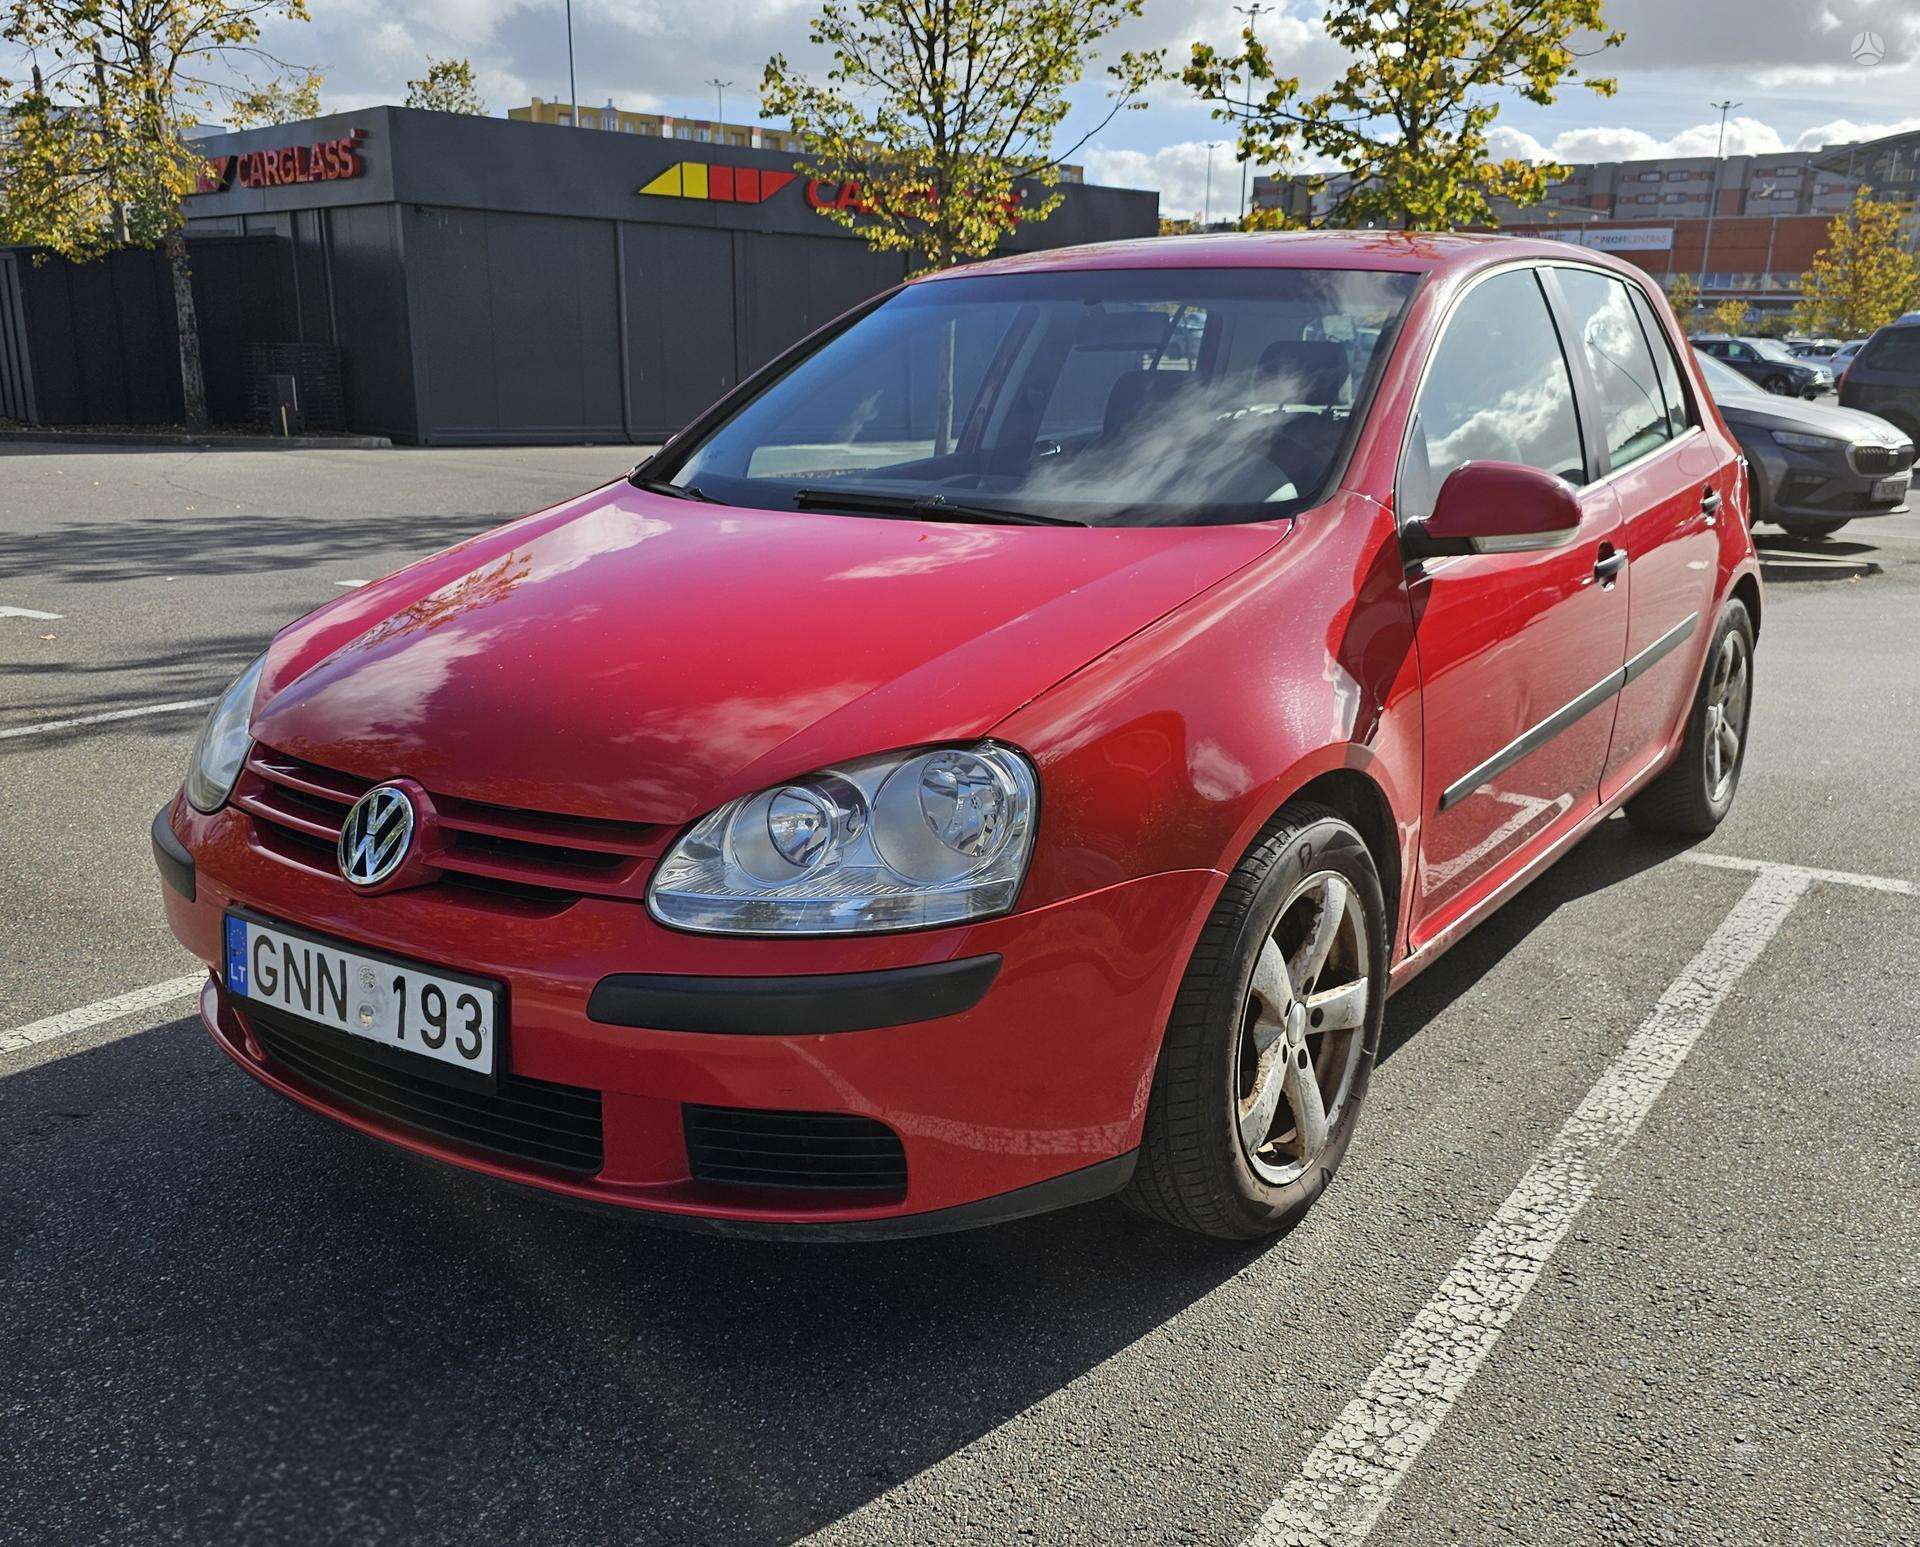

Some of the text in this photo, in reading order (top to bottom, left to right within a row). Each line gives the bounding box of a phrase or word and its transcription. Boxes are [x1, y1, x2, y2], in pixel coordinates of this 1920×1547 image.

[237, 137, 354, 187] CARGLASS
[230, 962, 246, 983] LT
[253, 934, 483, 1060] GNN 193
